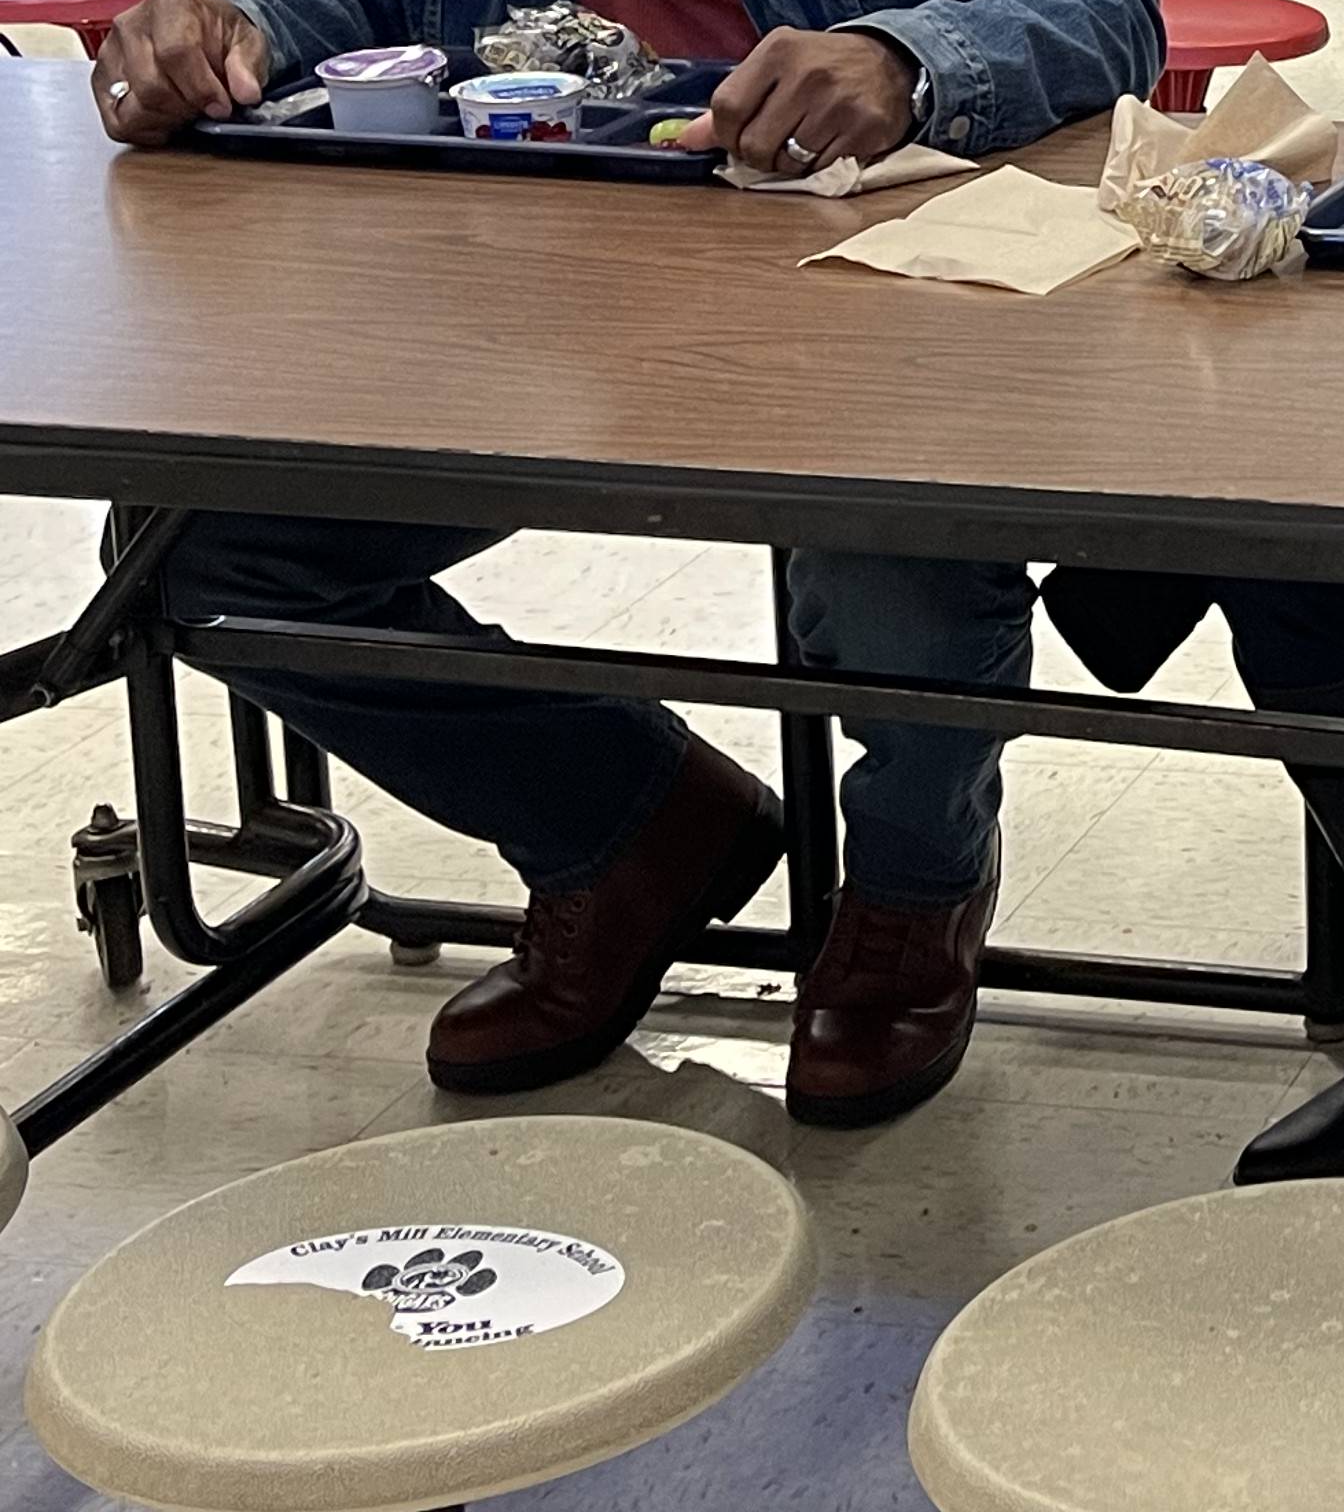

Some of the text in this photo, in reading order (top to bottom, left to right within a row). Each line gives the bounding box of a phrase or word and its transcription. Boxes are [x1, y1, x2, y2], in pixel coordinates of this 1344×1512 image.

[290, 1226, 616, 1276] Clay's Mill Elementary School
[417, 1319, 493, 1336] You
